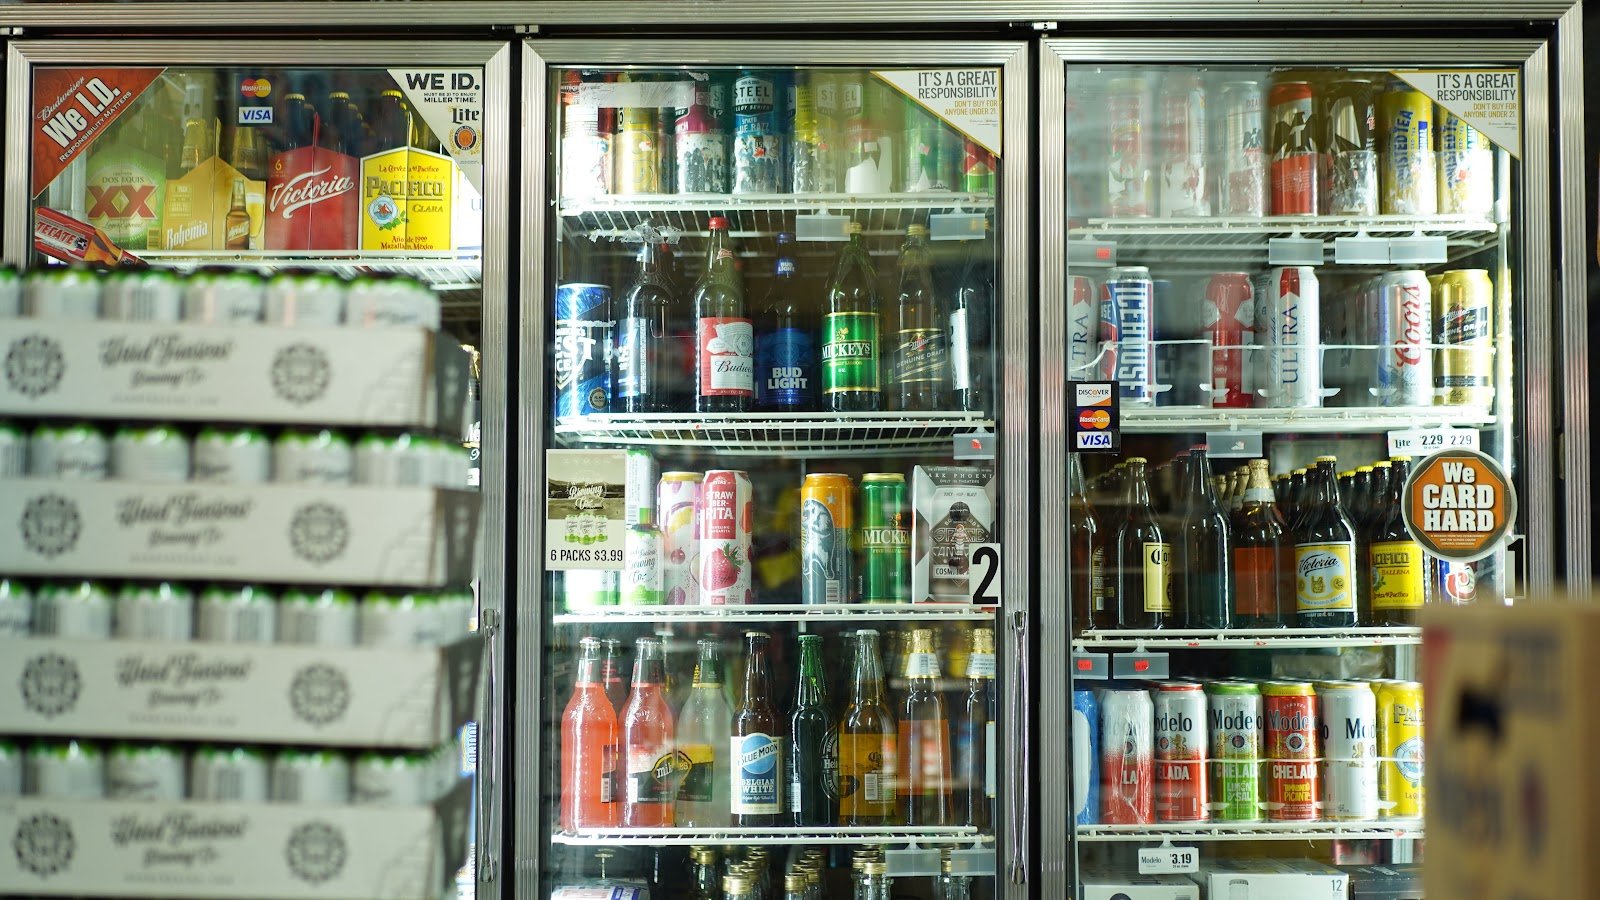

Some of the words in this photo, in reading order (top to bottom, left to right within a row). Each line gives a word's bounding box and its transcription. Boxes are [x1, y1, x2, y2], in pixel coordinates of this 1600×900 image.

[406, 74, 444, 90] WE
[452, 74, 480, 90] ID.
[919, 72, 941, 86] IT'S
[946, 72, 954, 86] A
[958, 71, 997, 86] GREAT
[1437, 74, 1460, 88] IT'S
[1464, 74, 1472, 88] A
[1476, 74, 1516, 88] GREAT
[37, 77, 84, 120] Budweiser
[919, 87, 997, 98] RESPONSIBILITY
[1437, 89, 1516, 100] RESPONSIBILITY
[42, 108, 88, 148] We
[75, 78, 121, 118] I.D.
[104, 91, 132, 119] MATTERS
[243, 110, 270, 120] VISA
[452, 108, 479, 124] Lite
[275, 160, 282, 170] 6
[270, 166, 354, 219] Victoria
[366, 176, 444, 197] PACIFICO
[88, 185, 158, 219] XX
[412, 204, 443, 212] CLARA
[37, 222, 77, 244] TECATE
[166, 221, 208, 250] Bohemia
[1395, 286, 1421, 367] Coors
[1282, 304, 1298, 384] ULTRA
[772, 367, 802, 378] BUD
[768, 378, 808, 389] LIGHT
[1080, 435, 1110, 445] VISA
[1395, 440, 1410, 448] Lite
[1451, 435, 1472, 445] 2.29
[1442, 462, 1475, 483] We
[568, 484, 603, 499] Brewing
[1423, 484, 1494, 509] CARD
[706, 508, 733, 519] RITA
[1424, 509, 1494, 532] HARD
[934, 528, 985, 542] SPCE
[550, 550, 557, 561] 6
[560, 550, 591, 561] PACKS
[594, 550, 623, 561] $3.99
[1299, 554, 1338, 577] Victoria
[1507, 538, 1524, 597] 1
[973, 547, 999, 604] 2
[1154, 712, 1192, 731] odelo
[1213, 709, 1263, 730] Modeo
[759, 744, 778, 757] MOON
[1160, 766, 1190, 780] ELADA
[1273, 765, 1318, 779] CHELADA
[1332, 880, 1342, 891] 12
